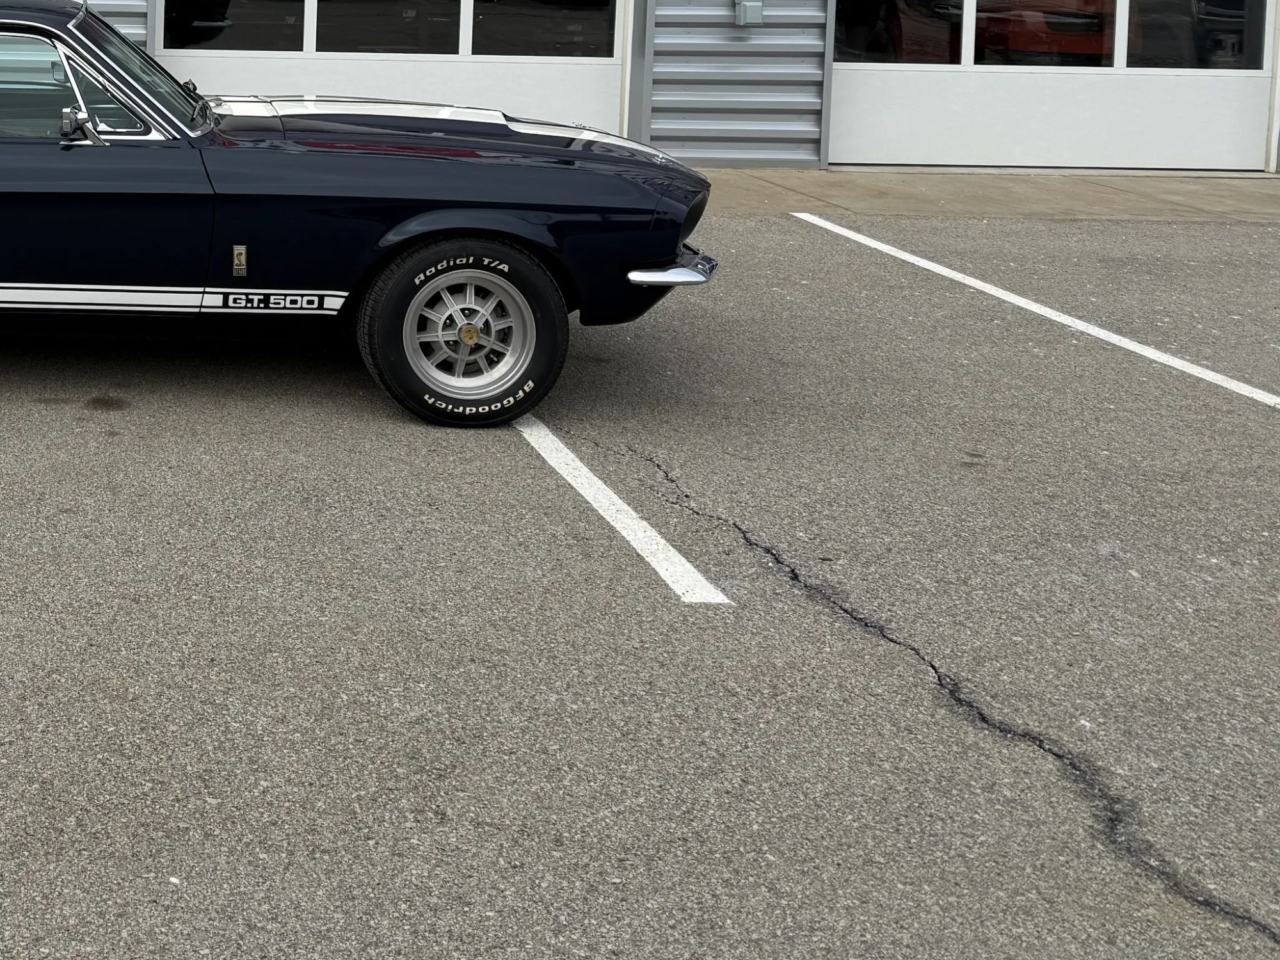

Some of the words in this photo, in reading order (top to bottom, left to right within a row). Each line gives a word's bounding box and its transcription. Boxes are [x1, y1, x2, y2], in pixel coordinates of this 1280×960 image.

[414, 256, 474, 286] Radial
[482, 257, 510, 273] T/A
[228, 294, 264, 308] G.T.
[269, 295, 319, 308] 500
[423, 379, 535, 415] BFGoodrich
